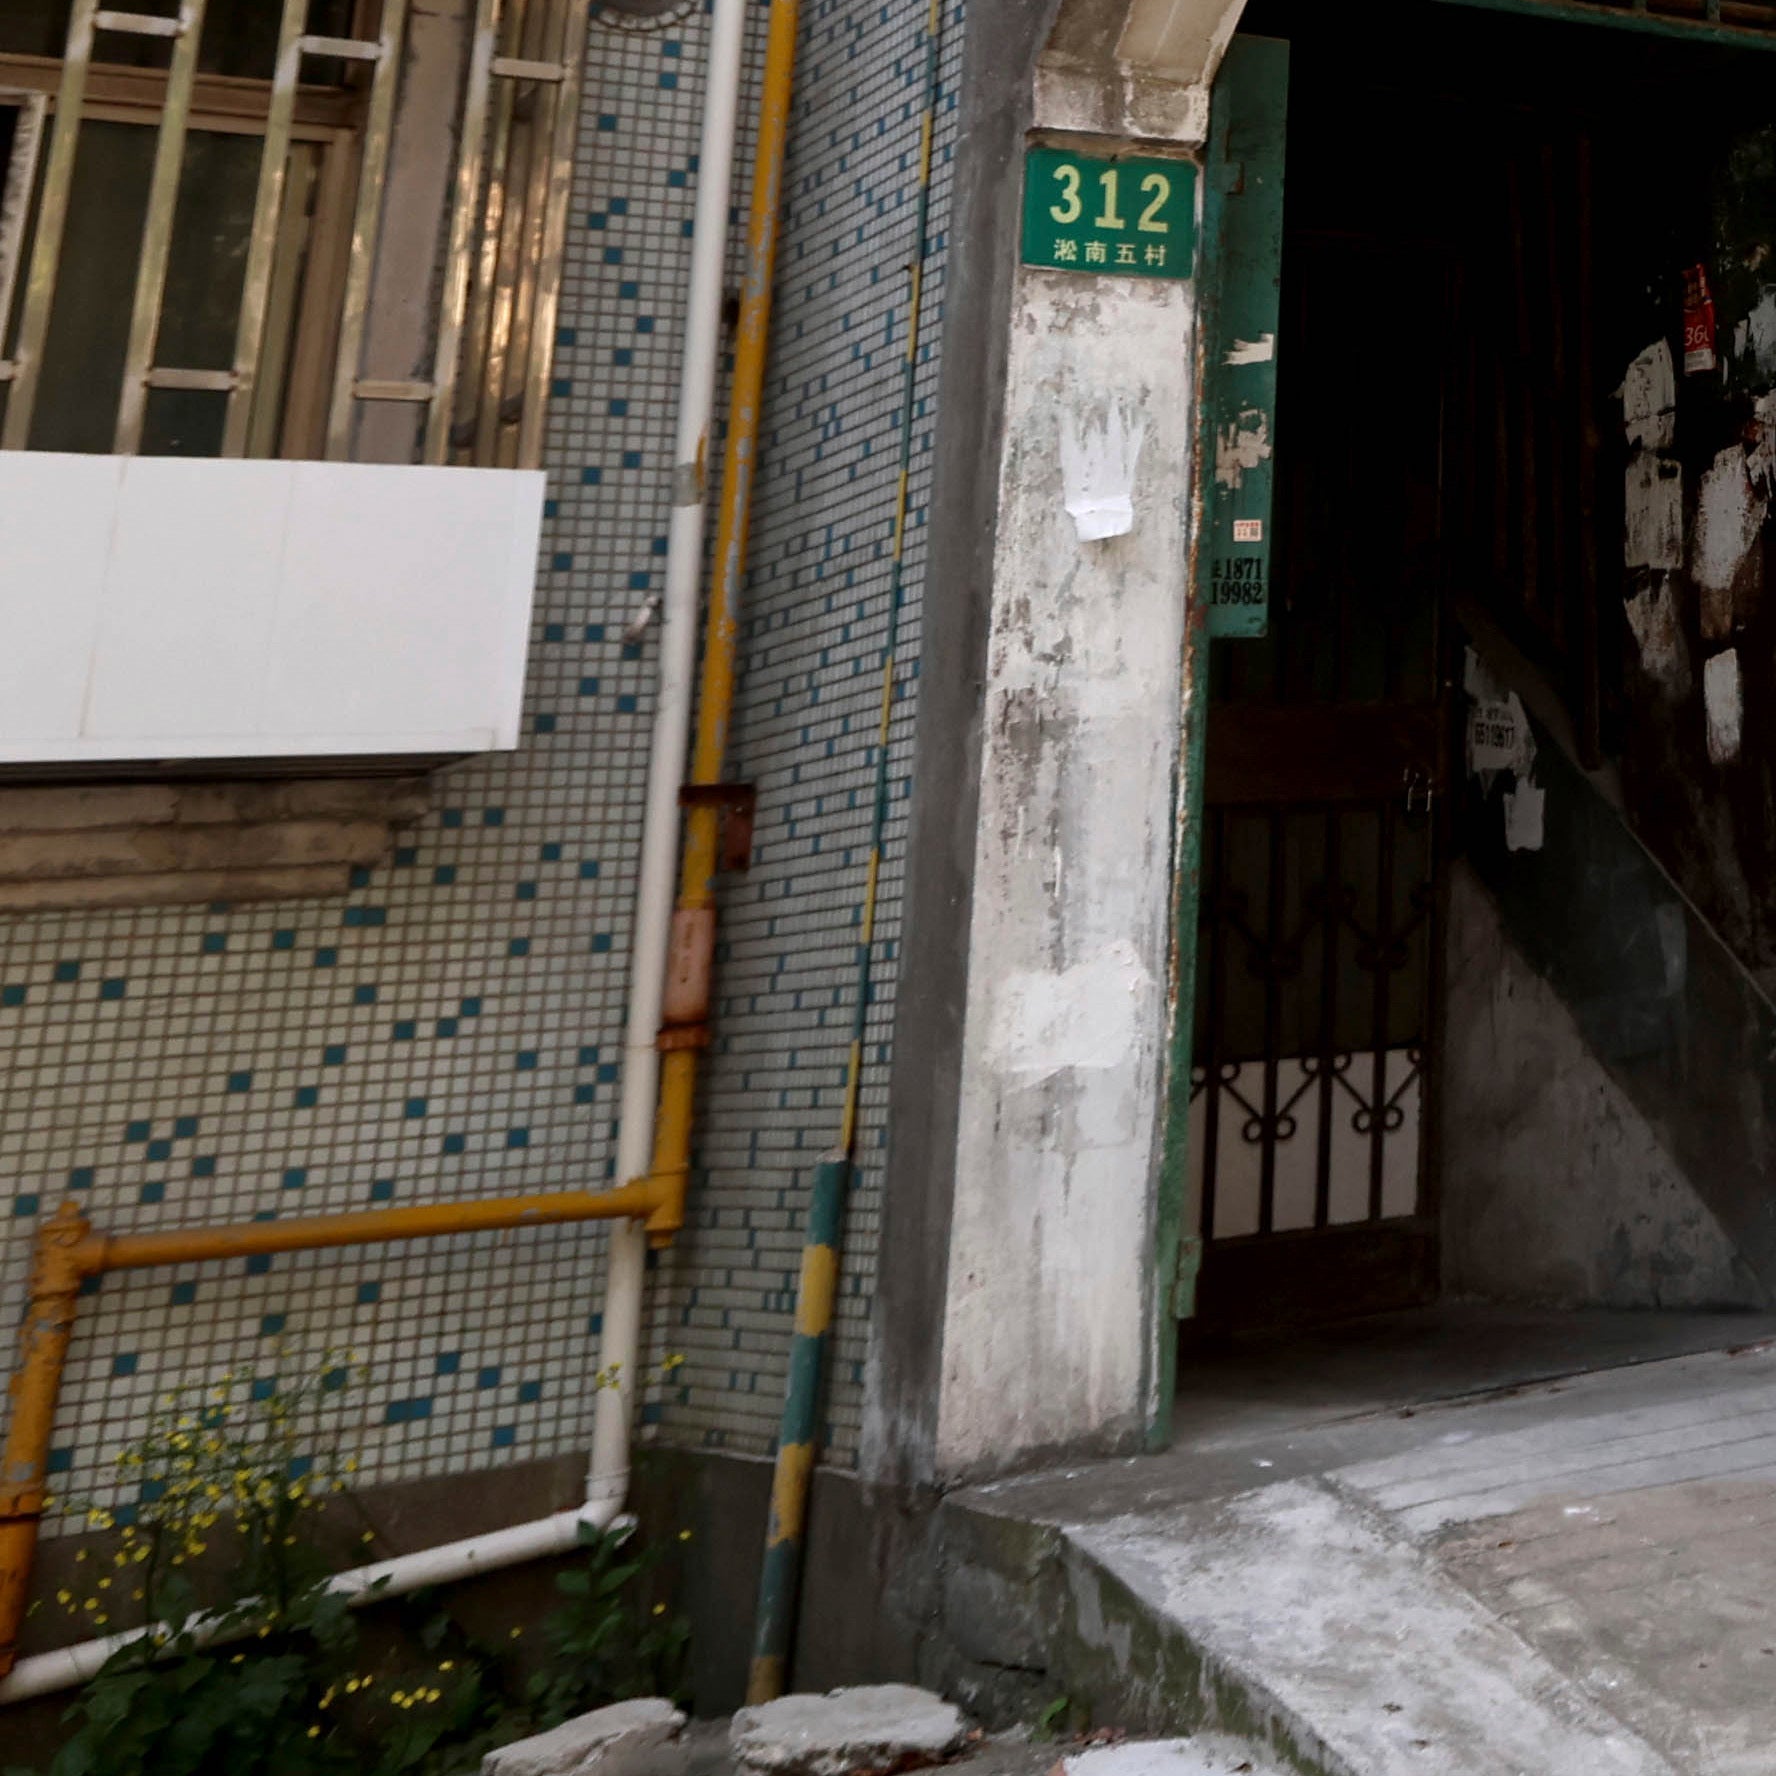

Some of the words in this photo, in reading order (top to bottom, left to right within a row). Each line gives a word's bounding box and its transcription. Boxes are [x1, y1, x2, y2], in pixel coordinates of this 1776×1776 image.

[1049, 164, 1171, 233] 312
[1053, 238, 1167, 267] 淞南五村
